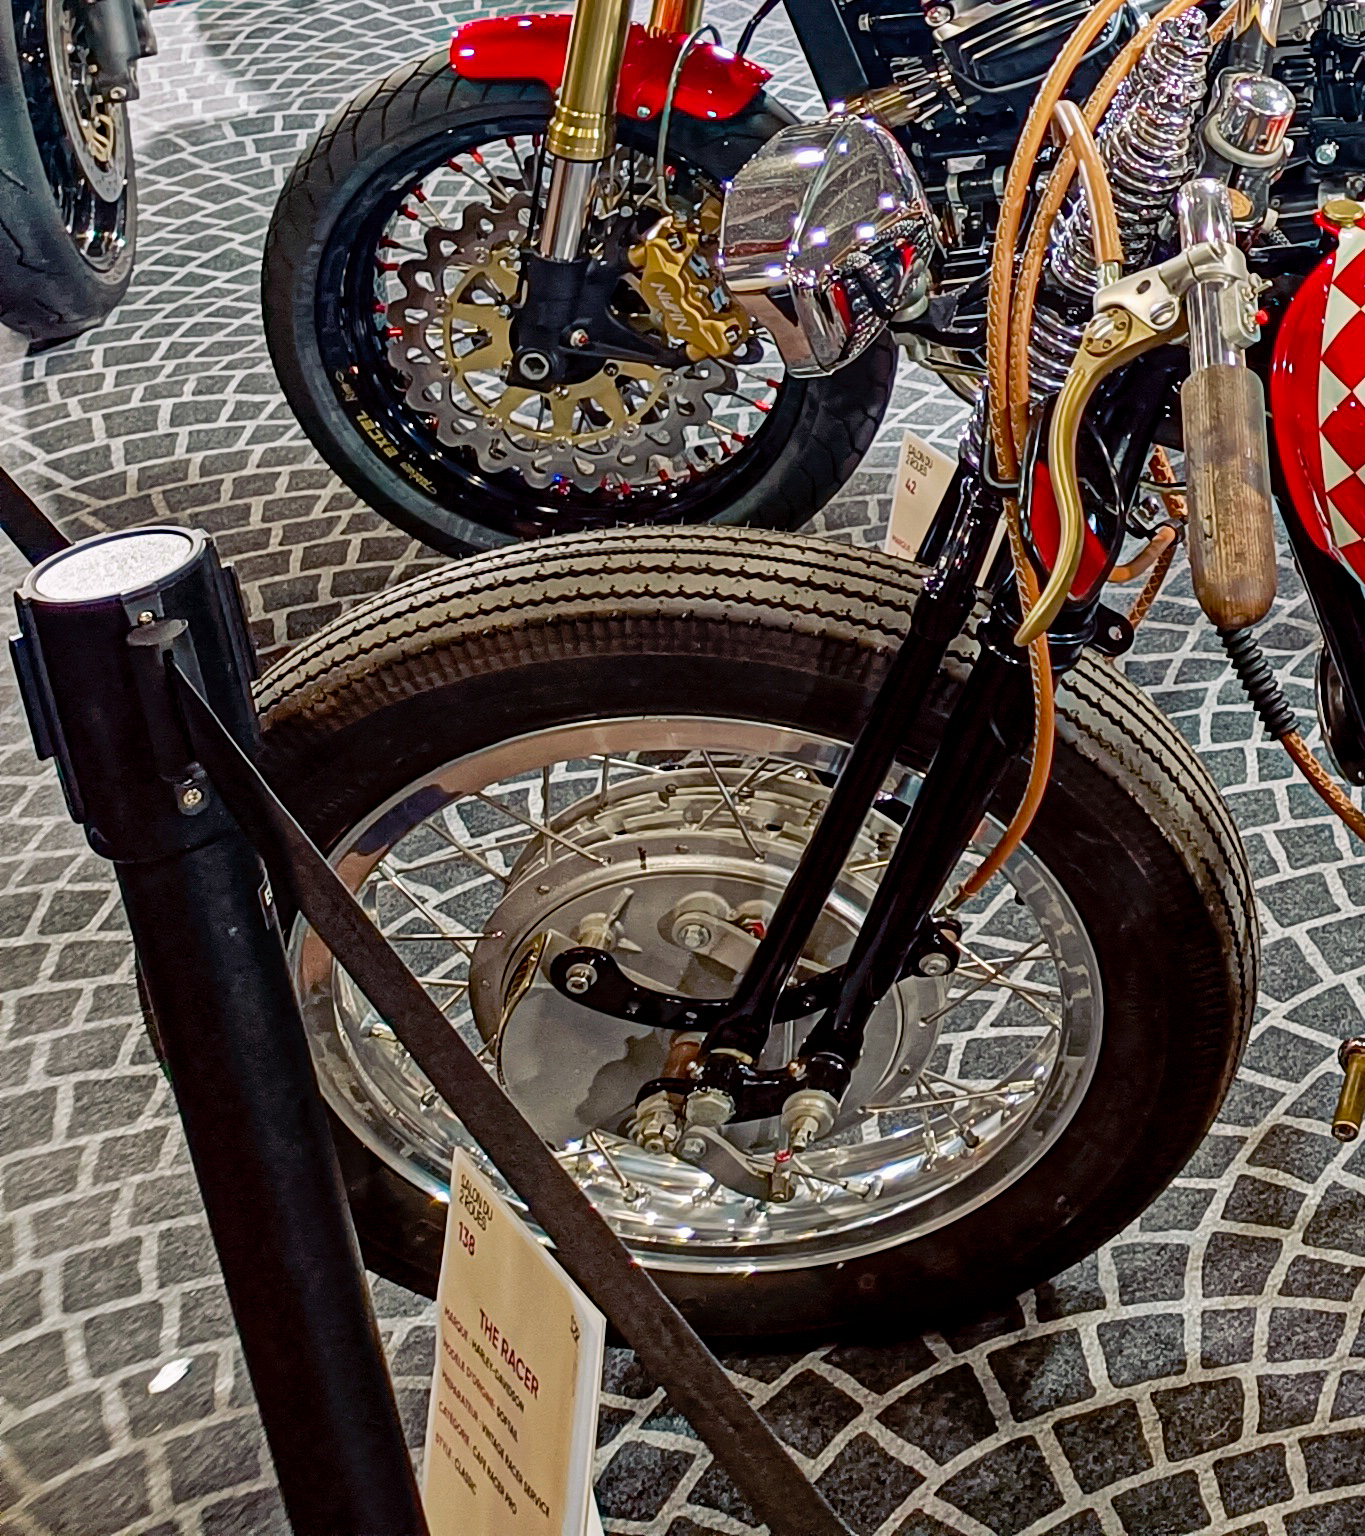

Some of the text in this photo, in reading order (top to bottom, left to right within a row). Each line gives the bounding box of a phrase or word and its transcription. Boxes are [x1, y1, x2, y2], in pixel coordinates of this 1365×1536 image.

[355, 409, 400, 459] EXCEL
[905, 477, 917, 496] 42
[458, 1188, 487, 1232] 2 ROUES
[461, 1173, 494, 1222] SALON DU
[458, 1221, 476, 1257] 138
[479, 1307, 539, 1401] THE RACER
